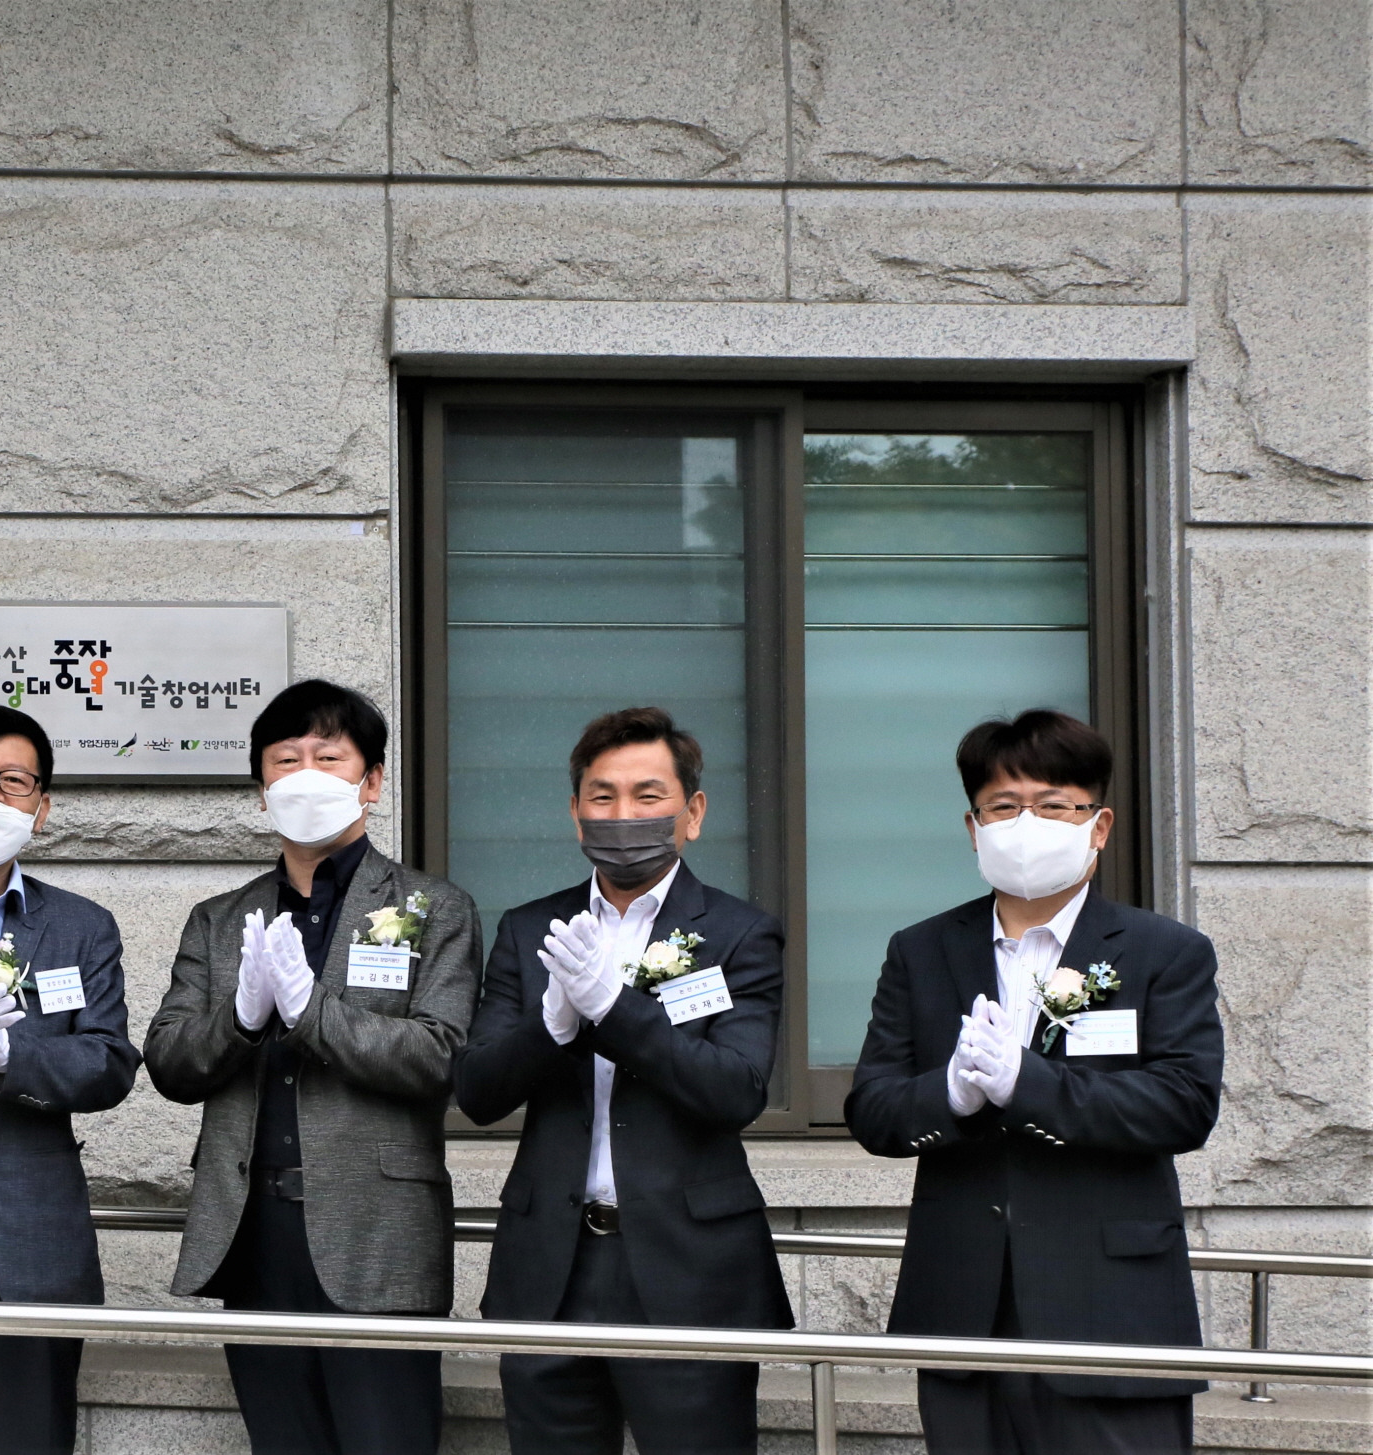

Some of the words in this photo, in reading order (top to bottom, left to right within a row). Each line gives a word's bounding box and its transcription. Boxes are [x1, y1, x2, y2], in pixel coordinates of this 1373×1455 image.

[114, 674, 261, 710] 기술창업센터
[78, 738, 120, 749] 창업진흥원
[202, 739, 247, 750] 건양대학교
[369, 973, 404, 984] 김경한
